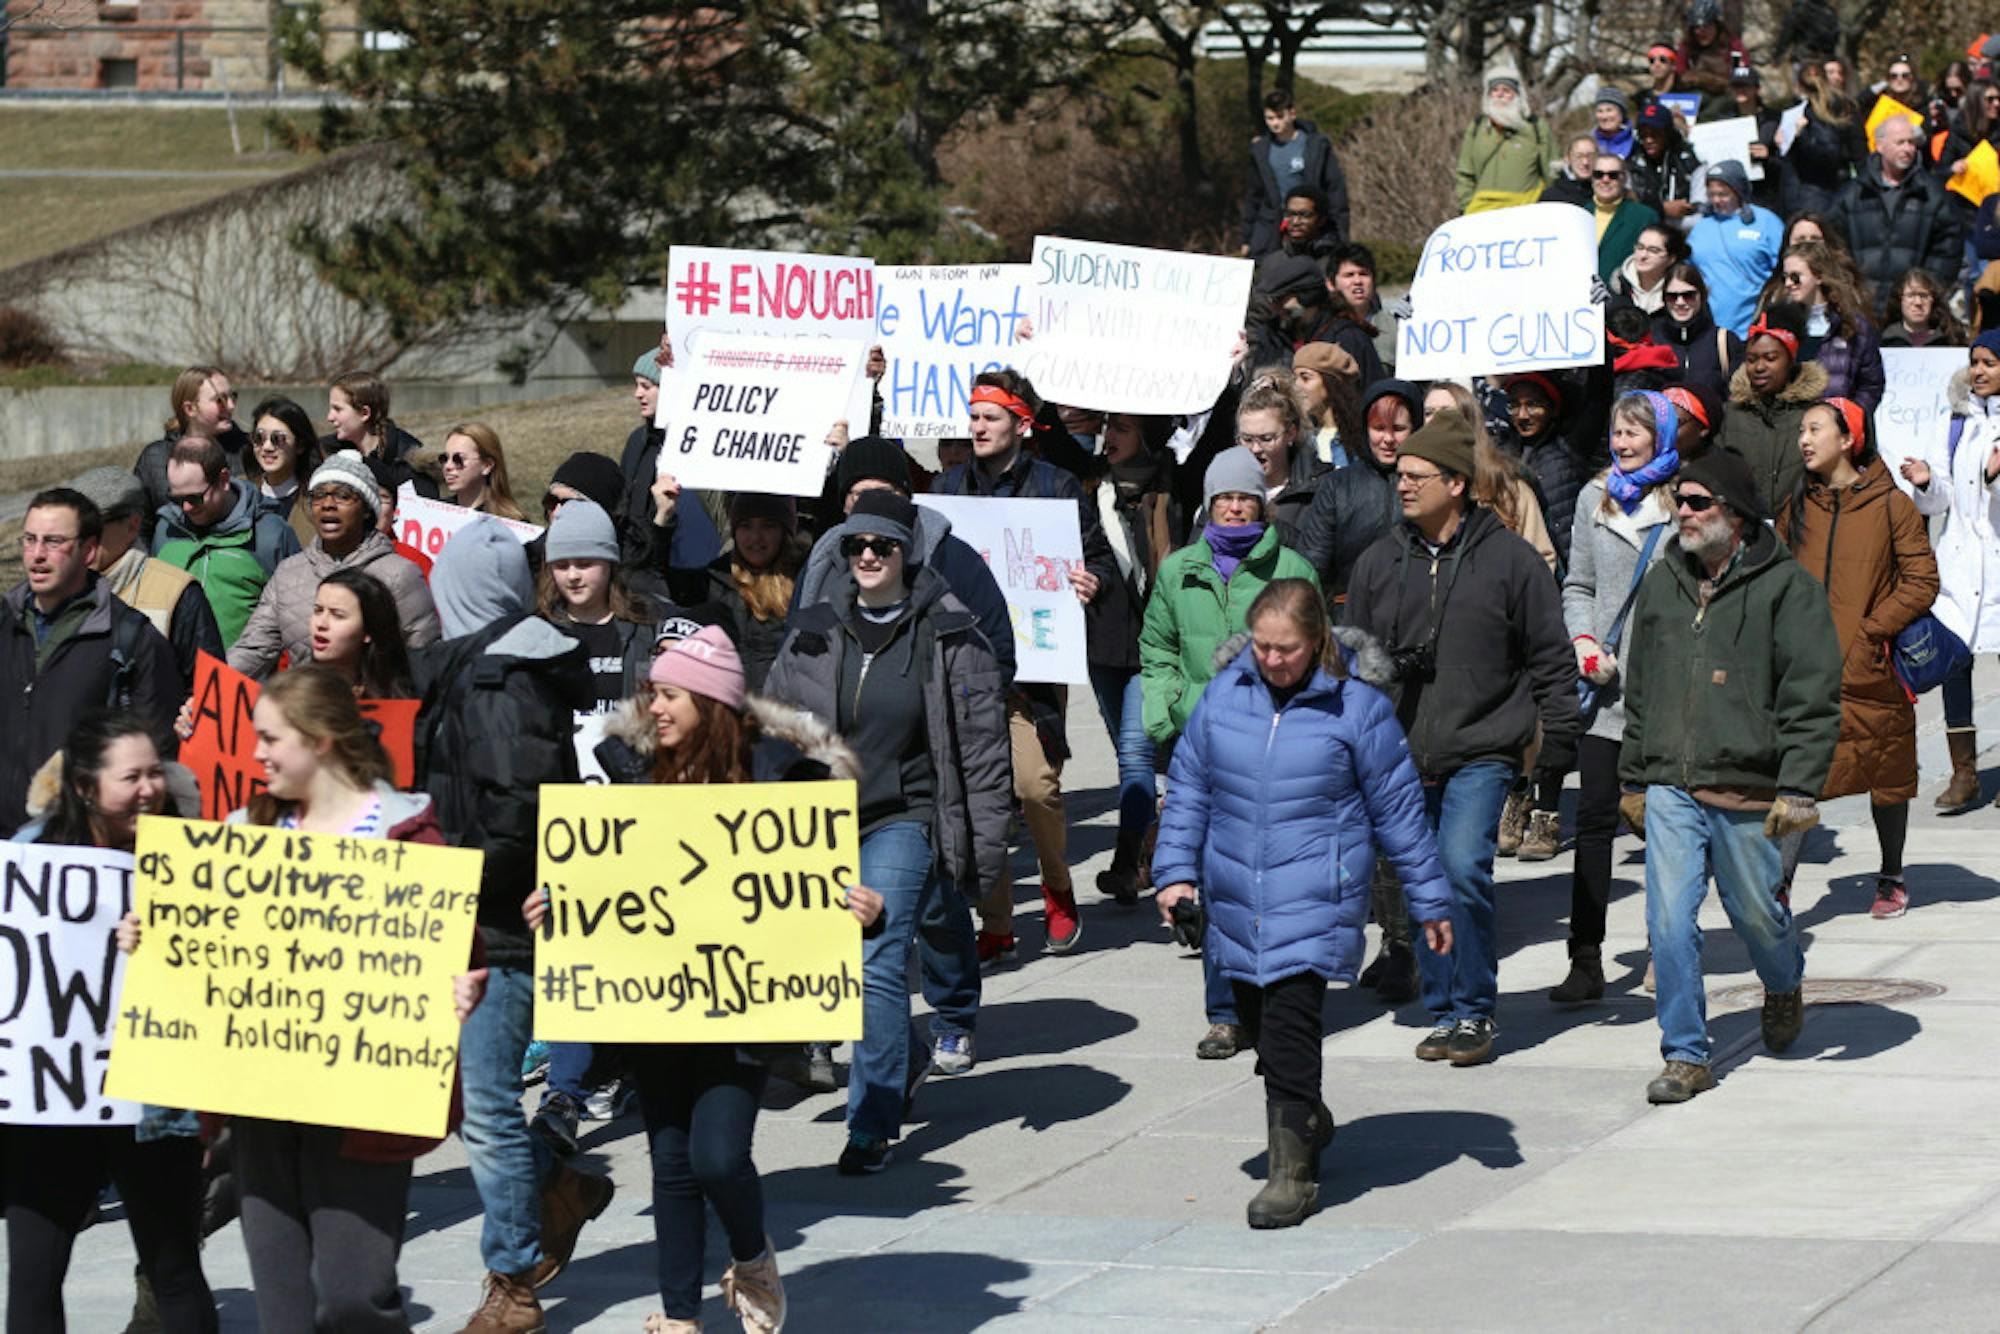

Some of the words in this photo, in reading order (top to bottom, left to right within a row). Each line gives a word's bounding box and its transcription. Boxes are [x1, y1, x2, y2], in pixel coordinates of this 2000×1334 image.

[896, 267, 923, 281] GUN
[1037, 246, 1141, 291] STUDENTS
[1420, 233, 1558, 277] PROTECT
[675, 261, 874, 321] #ENOUGH
[920, 285, 1029, 347] Want
[1406, 317, 1477, 356] NOT
[1488, 307, 1597, 360] GUNS
[1024, 351, 1090, 391] GUN
[693, 383, 779, 415] POLICY
[680, 426, 698, 454] &
[712, 428, 806, 464] CHANGE
[184, 824, 269, 859] Why
[335, 838, 407, 871] that
[3, 860, 133, 923] NOT
[140, 851, 175, 886] as
[193, 860, 213, 890] a
[384, 881, 424, 909] we
[430, 888, 478, 915] are
[543, 882, 675, 942] lives
[732, 865, 853, 924] guns
[149, 899, 240, 929] more
[264, 903, 444, 942] comfortable
[286, 939, 343, 974] two
[358, 949, 422, 977] men
[206, 974, 325, 1022] holding
[343, 989, 430, 1022] guns
[123, 1005, 198, 1041] than
[225, 1014, 340, 1066] holding
[354, 1027, 458, 1089] hands?
